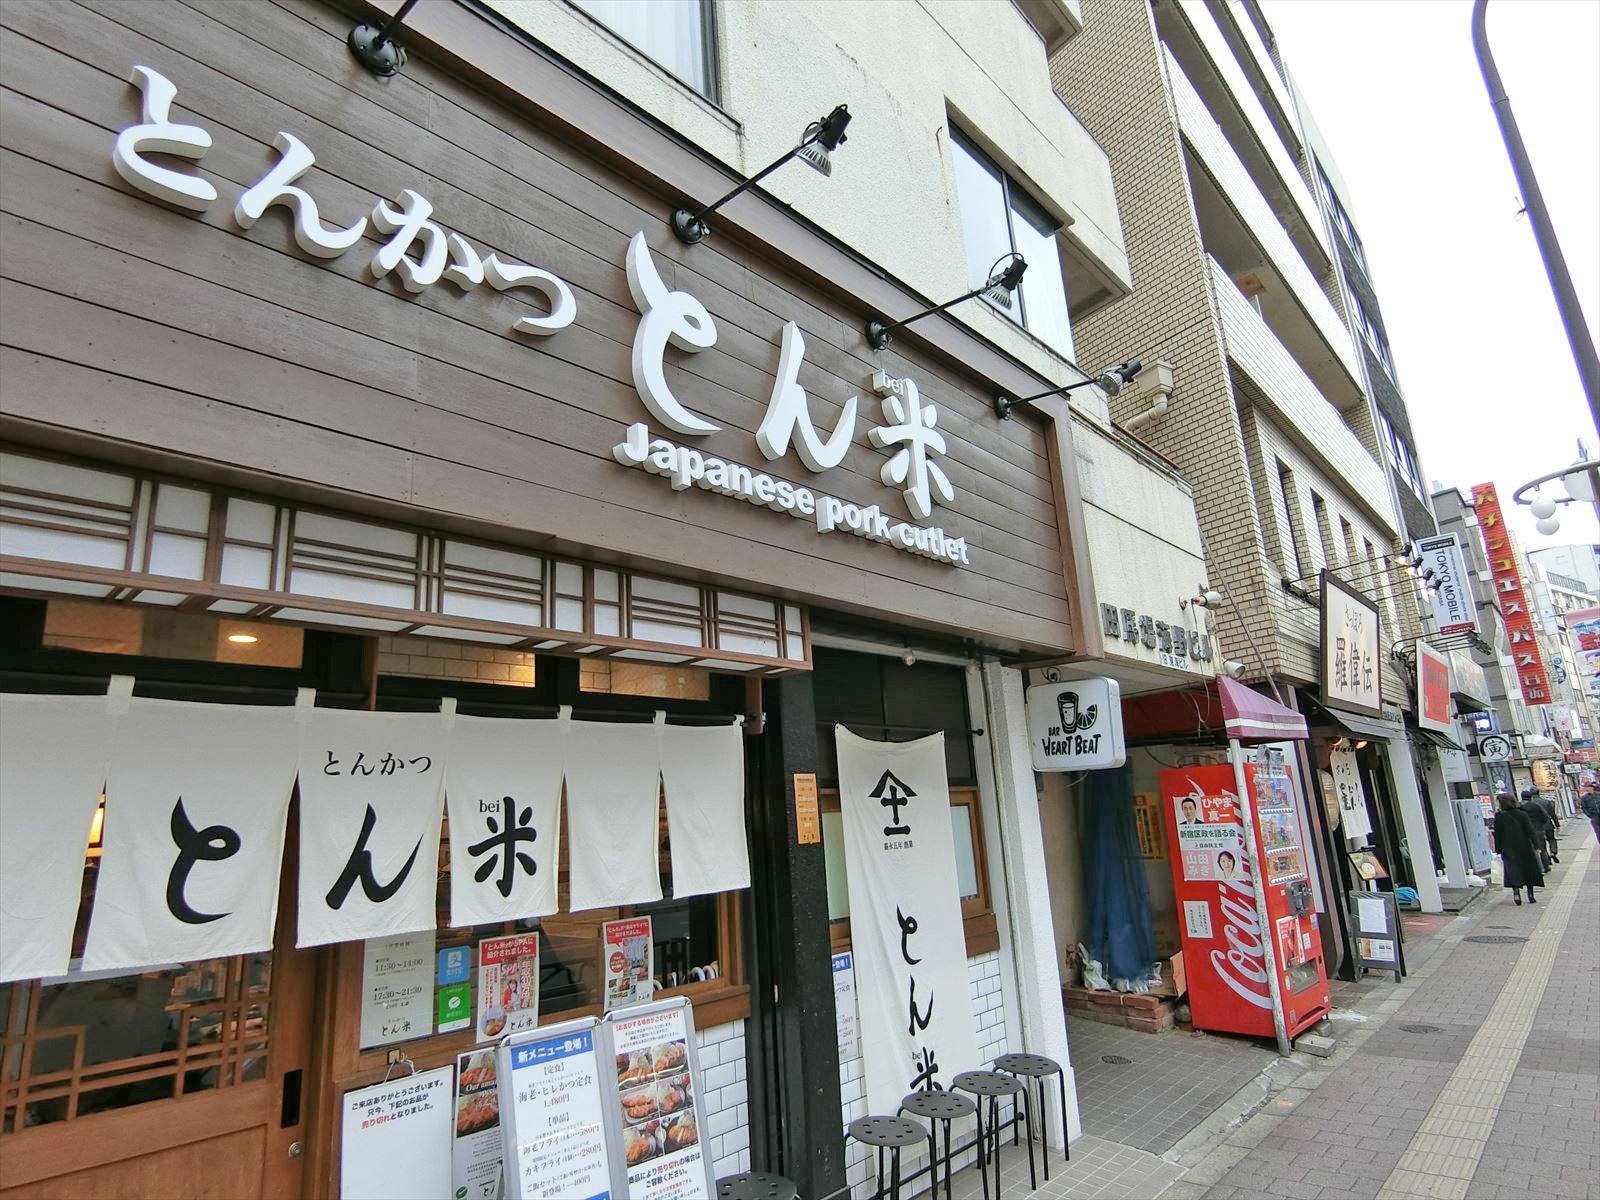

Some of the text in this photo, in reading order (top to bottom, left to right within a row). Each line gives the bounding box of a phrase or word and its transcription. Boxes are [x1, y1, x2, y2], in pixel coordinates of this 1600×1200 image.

[113, 65, 577, 336] とんかつ
[872, 369, 906, 398] bei
[612, 422, 970, 565] Japanese pork cutlet
[1435, 549, 1452, 583] TOKYO
[1443, 584, 1461, 622] MOBILE
[1042, 734, 1101, 757] HEART BEAT
[323, 750, 433, 777] とんかつ
[479, 800, 501, 813] bei
[1202, 796, 1233, 808] ひやま
[1180, 829, 1236, 839] 新宿区政を語る会
[1186, 853, 1208, 865] 山田
[518, 1037, 588, 1063] 新メニュー登場！
[352, 1079, 444, 1110] ご来店ありがとうございます。
[367, 1092, 429, 1117] 只今、下記のお品が
[361, 1103, 434, 1129] 売り切れとなりました。
[628, 1152, 700, 1184] 商品により売り切れの場合は
